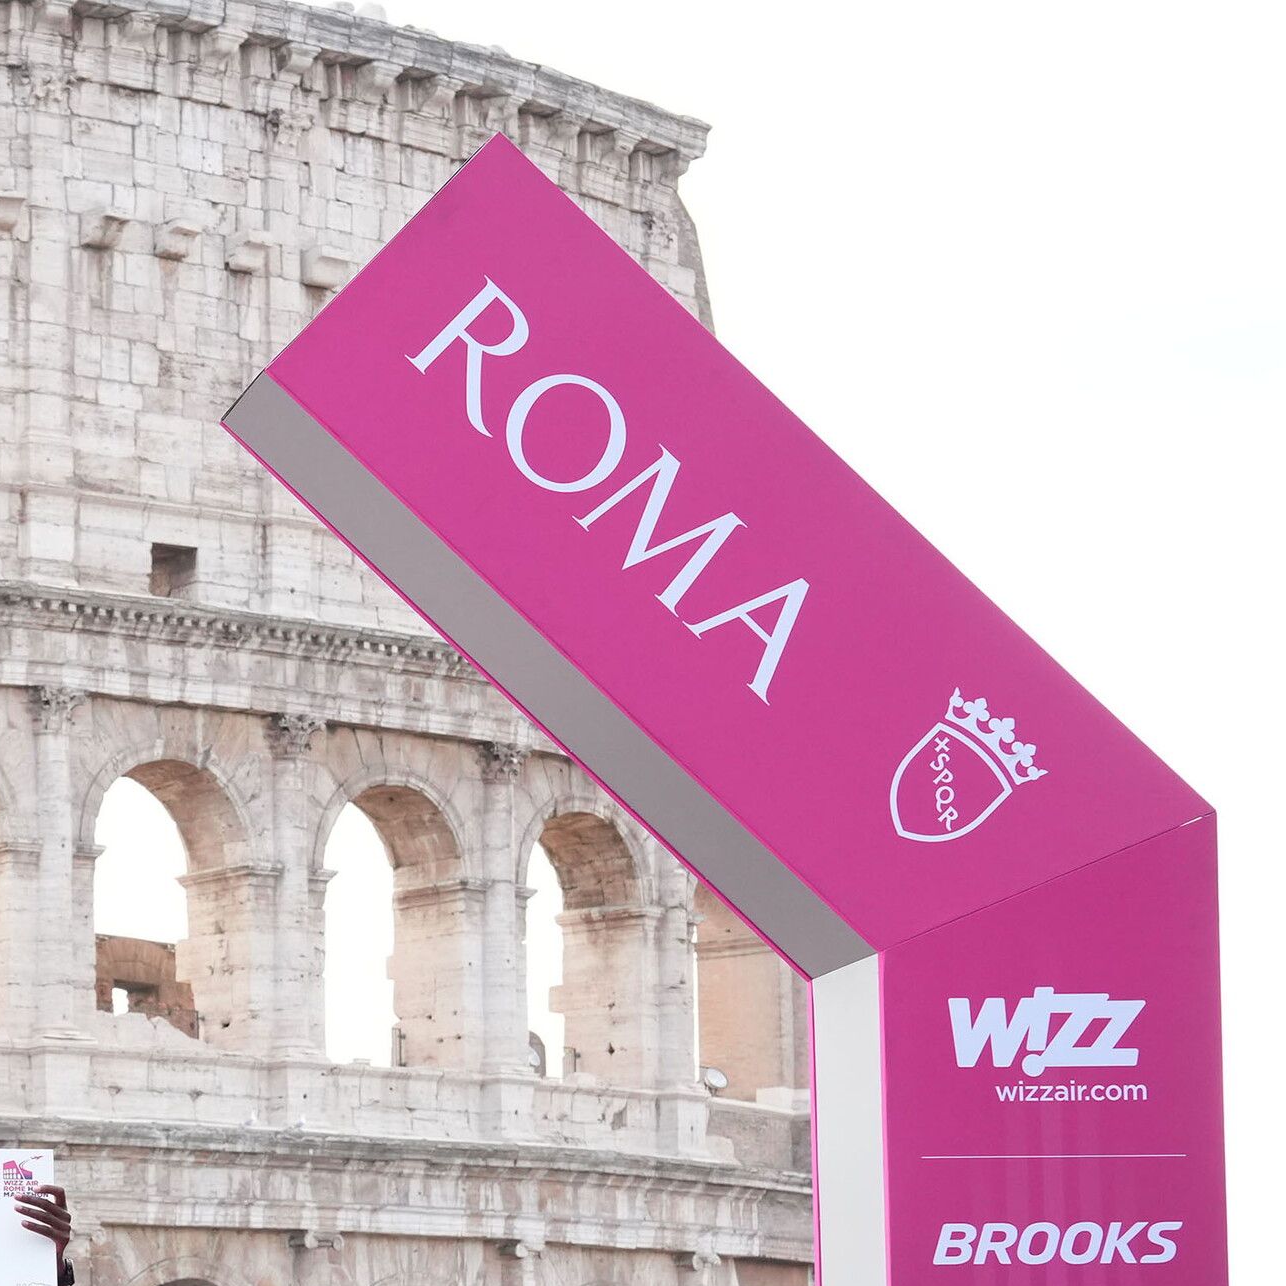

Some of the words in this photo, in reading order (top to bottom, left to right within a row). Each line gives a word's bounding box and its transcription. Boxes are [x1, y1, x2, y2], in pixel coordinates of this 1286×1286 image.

[404, 274, 810, 705] ROMA
[995, 1080, 1148, 1102] wizzair.com
[933, 1222, 1183, 1265] BROOKS
